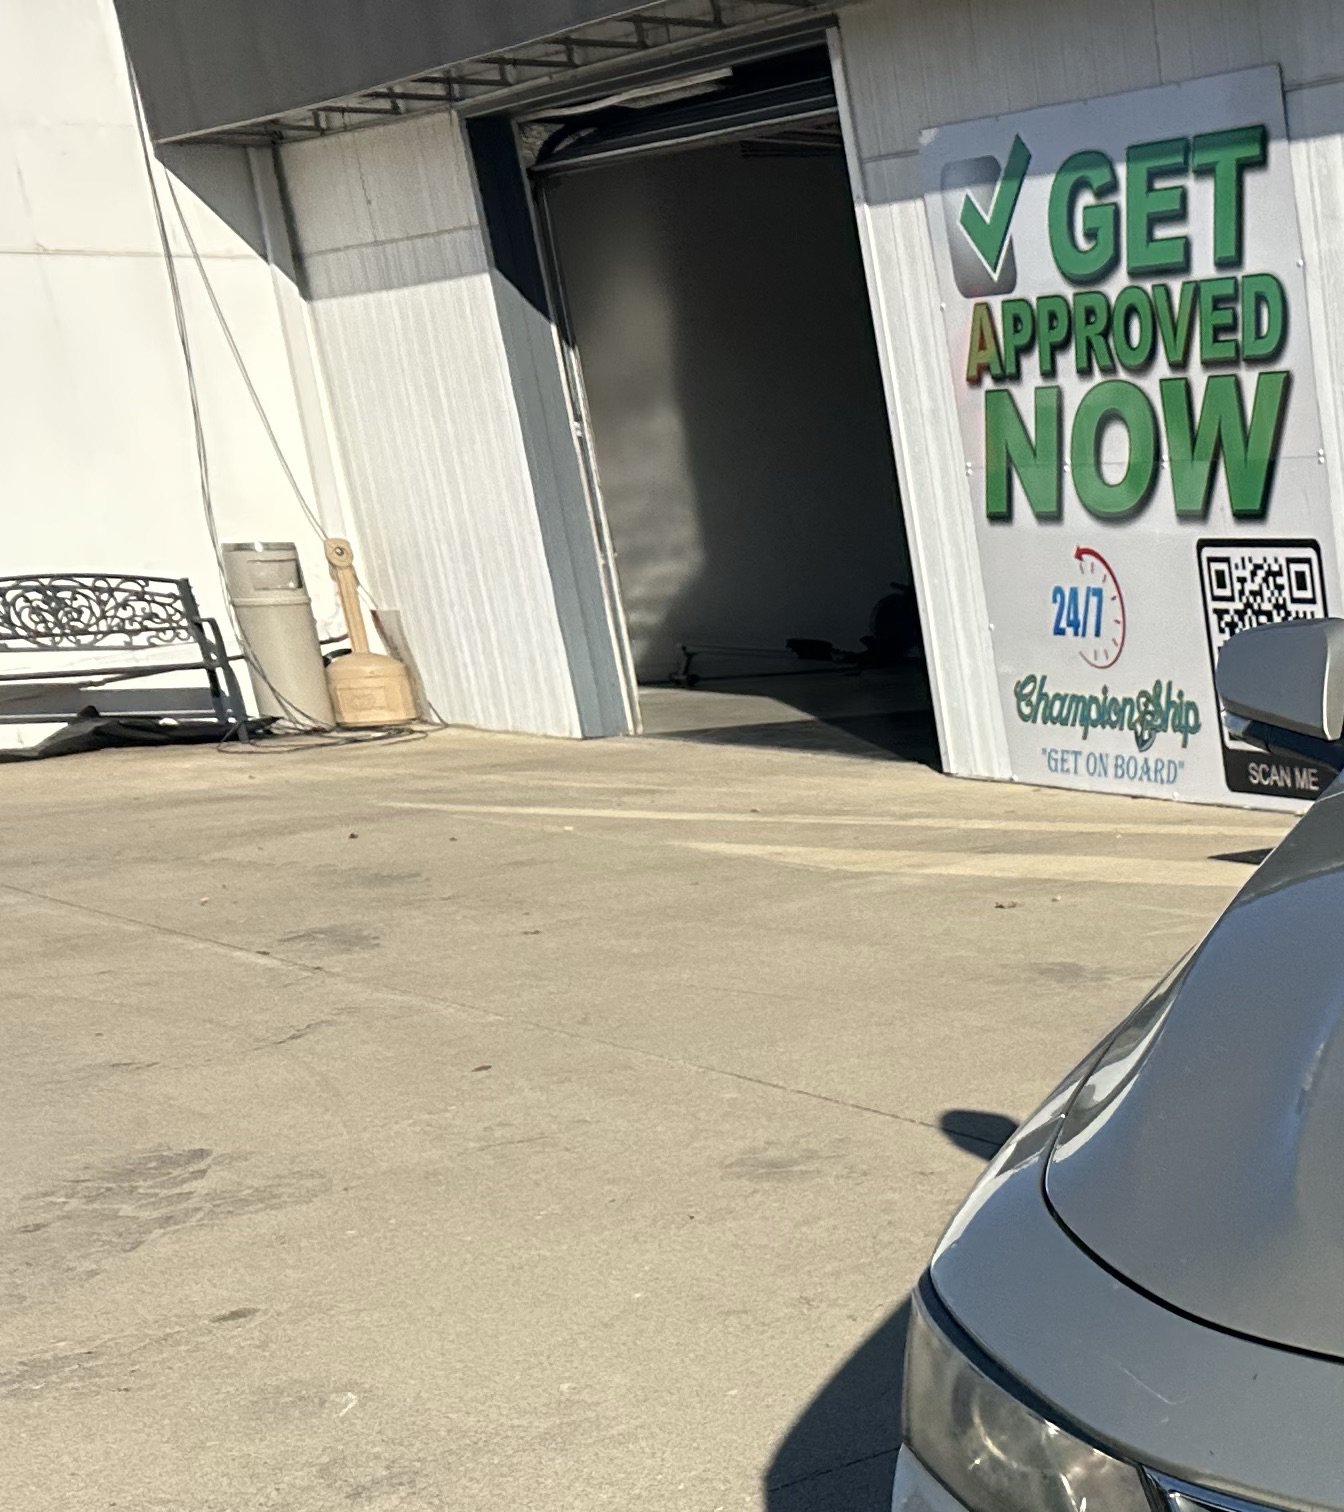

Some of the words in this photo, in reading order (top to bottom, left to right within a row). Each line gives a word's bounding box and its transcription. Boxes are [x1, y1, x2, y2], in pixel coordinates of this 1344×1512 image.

[1048, 126, 1266, 284] GET
[966, 272, 1286, 382] APPROVED
[985, 371, 1291, 523] NOW
[1052, 585, 1103, 637] 24/7
[1042, 748, 1081, 773] "GET
[1086, 752, 1109, 778] ON
[1114, 753, 1184, 784] BOARD"
[1249, 762, 1291, 788] SCAN
[1295, 767, 1319, 790] ME
